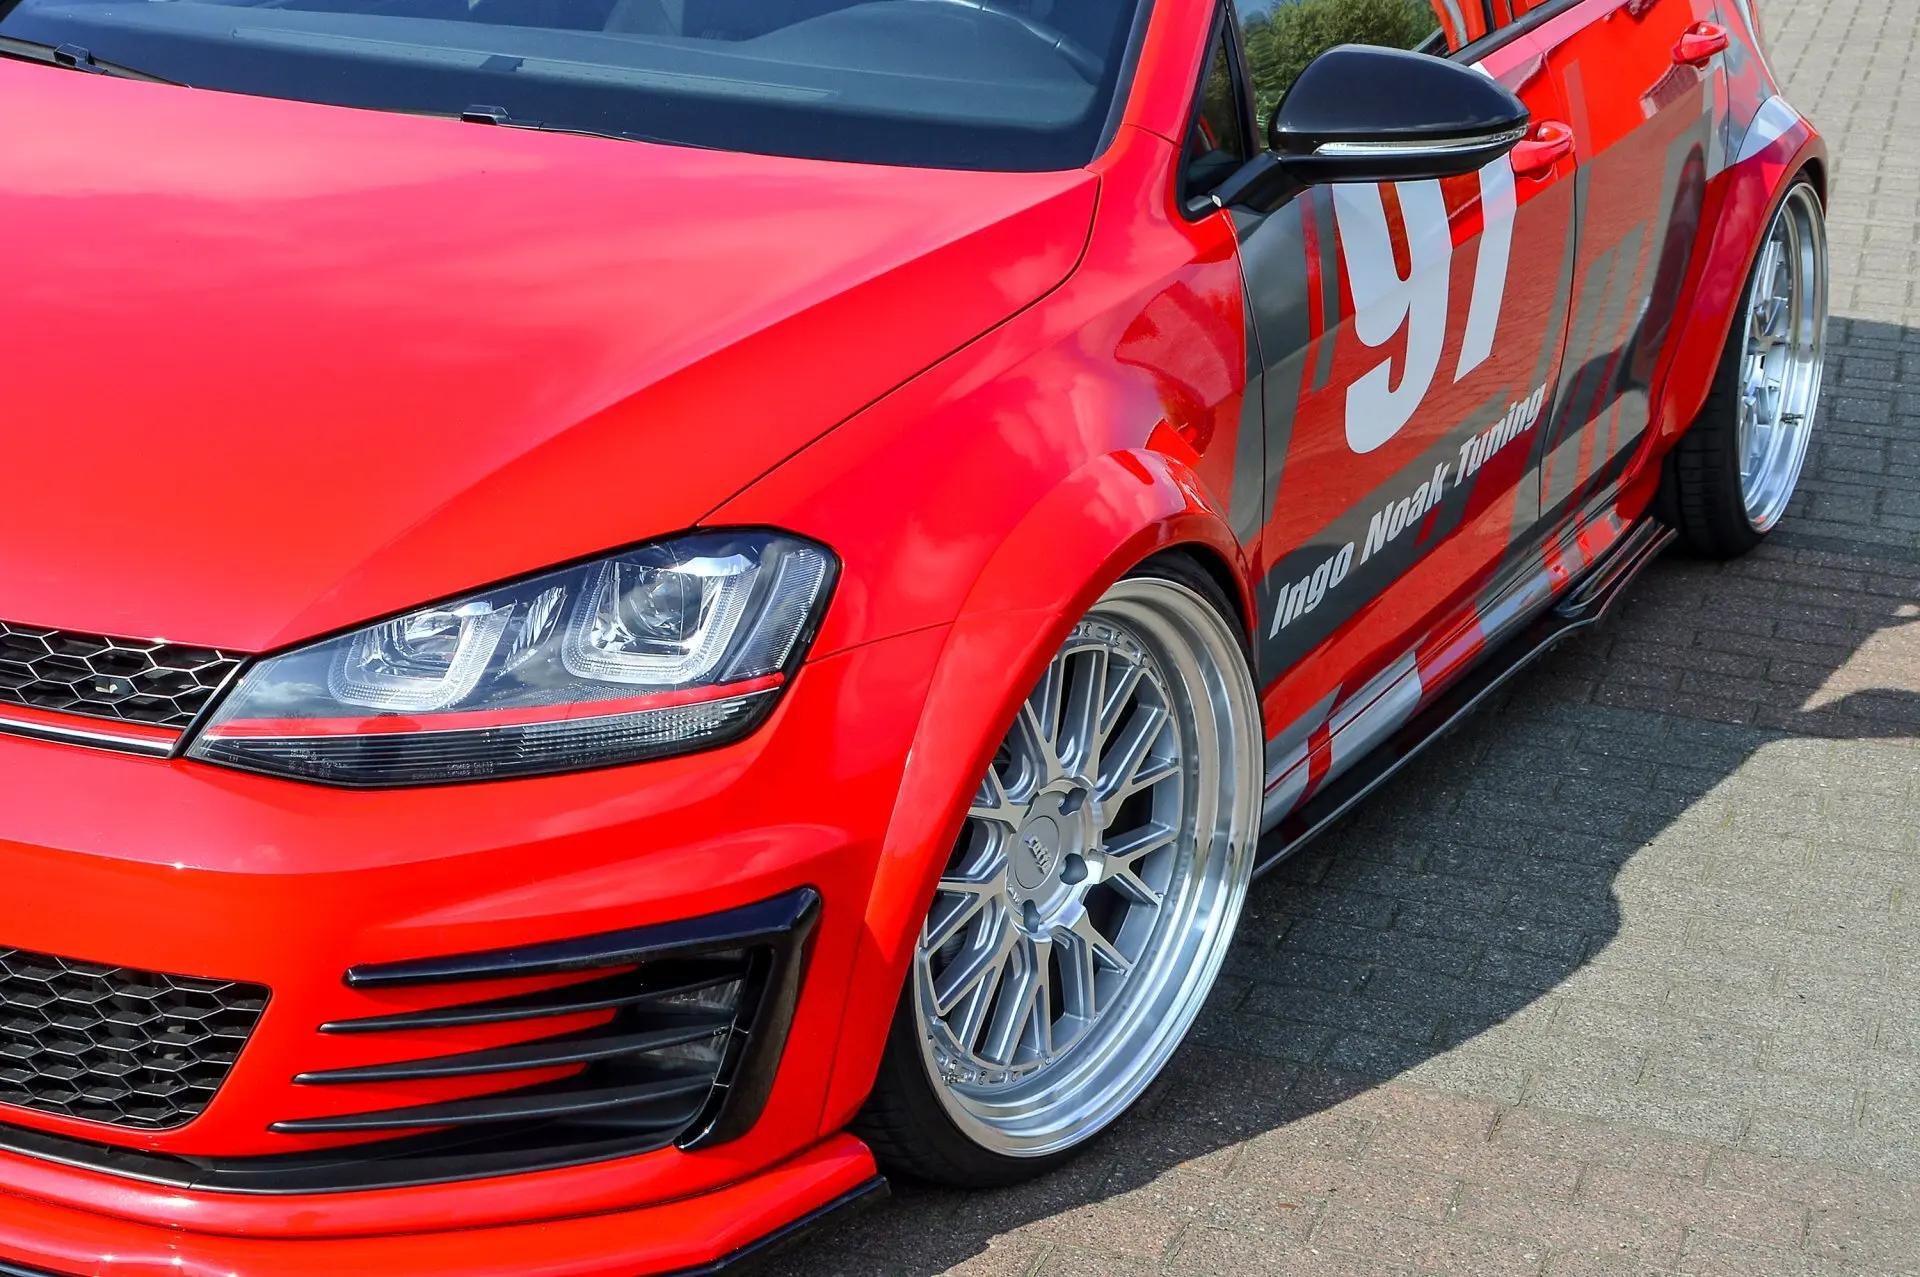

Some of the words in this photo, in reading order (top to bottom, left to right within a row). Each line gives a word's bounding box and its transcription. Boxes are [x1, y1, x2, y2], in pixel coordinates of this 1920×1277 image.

[1269, 541, 1355, 640] Ingo
[1360, 461, 1452, 566] Noak
[1454, 382, 1547, 488] Tuning
